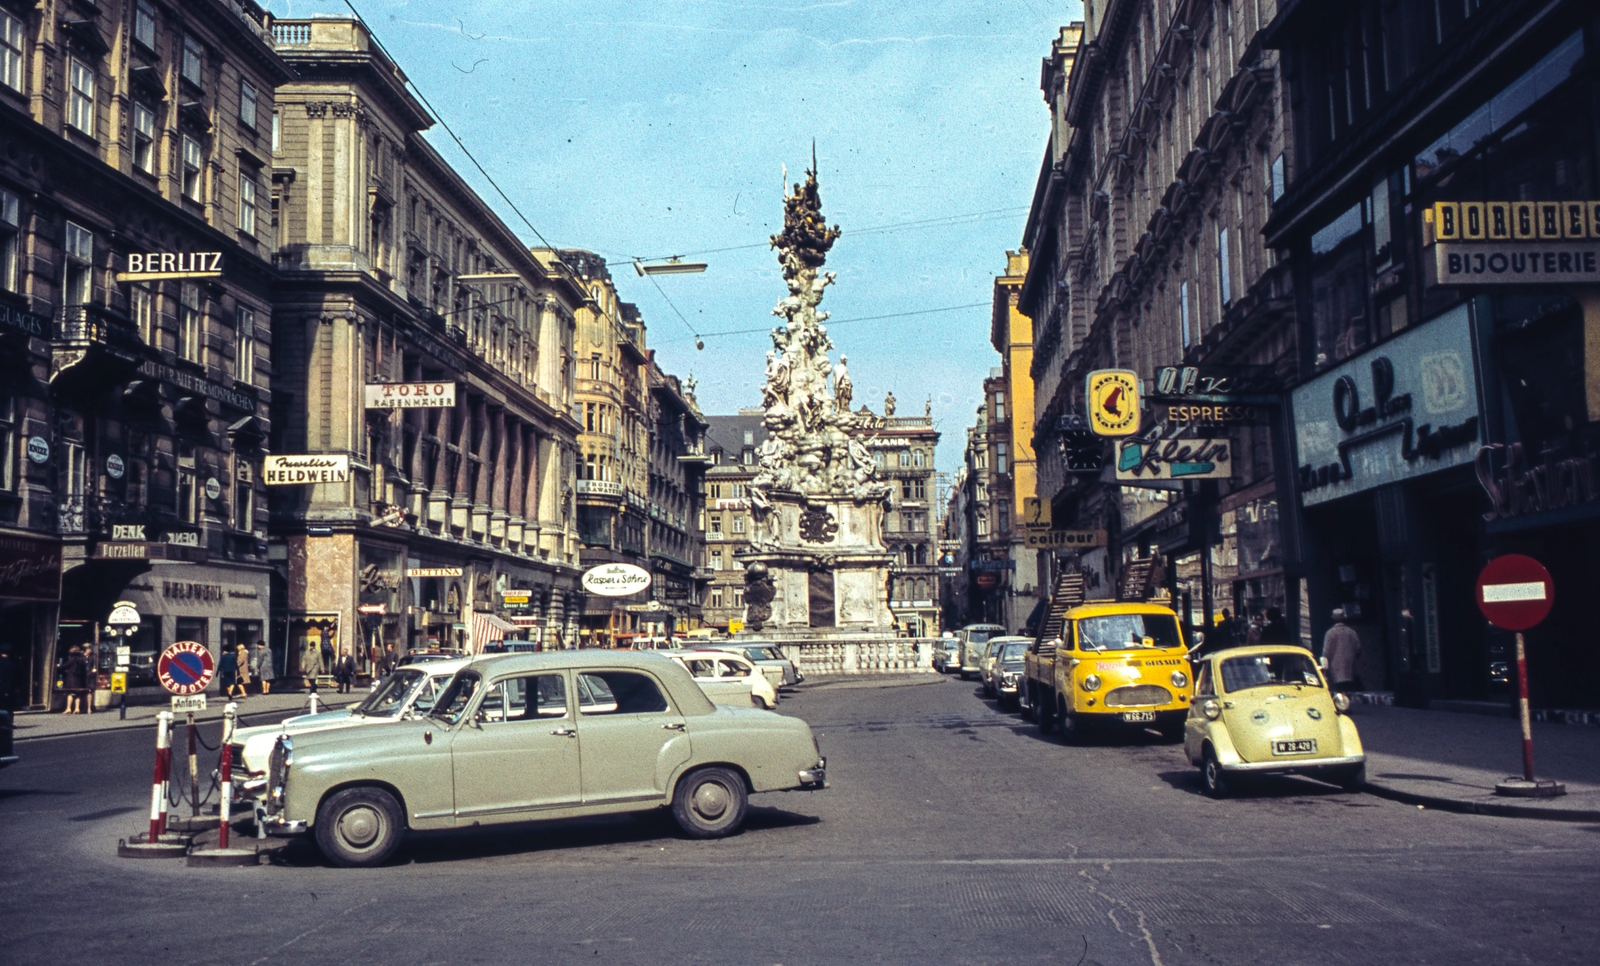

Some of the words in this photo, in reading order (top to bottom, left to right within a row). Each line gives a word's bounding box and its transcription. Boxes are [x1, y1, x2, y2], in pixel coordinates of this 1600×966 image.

[128, 251, 222, 273] BERLITZ
[1448, 252, 1597, 274] BIJOUTERIE
[194, 377, 254, 411] FREMDSPRACHEN
[382, 383, 444, 397] TORO
[1168, 406, 1257, 421] ESPRESSO
[29, 444, 48, 456] KNIZE
[267, 470, 346, 482] HELDWEIN
[112, 524, 146, 539] DENK
[1029, 532, 1093, 544] coiffeur
[165, 642, 206, 659] HALTEN
[161, 669, 213, 694] VERBOTEN
[177, 698, 201, 709] Anfang
